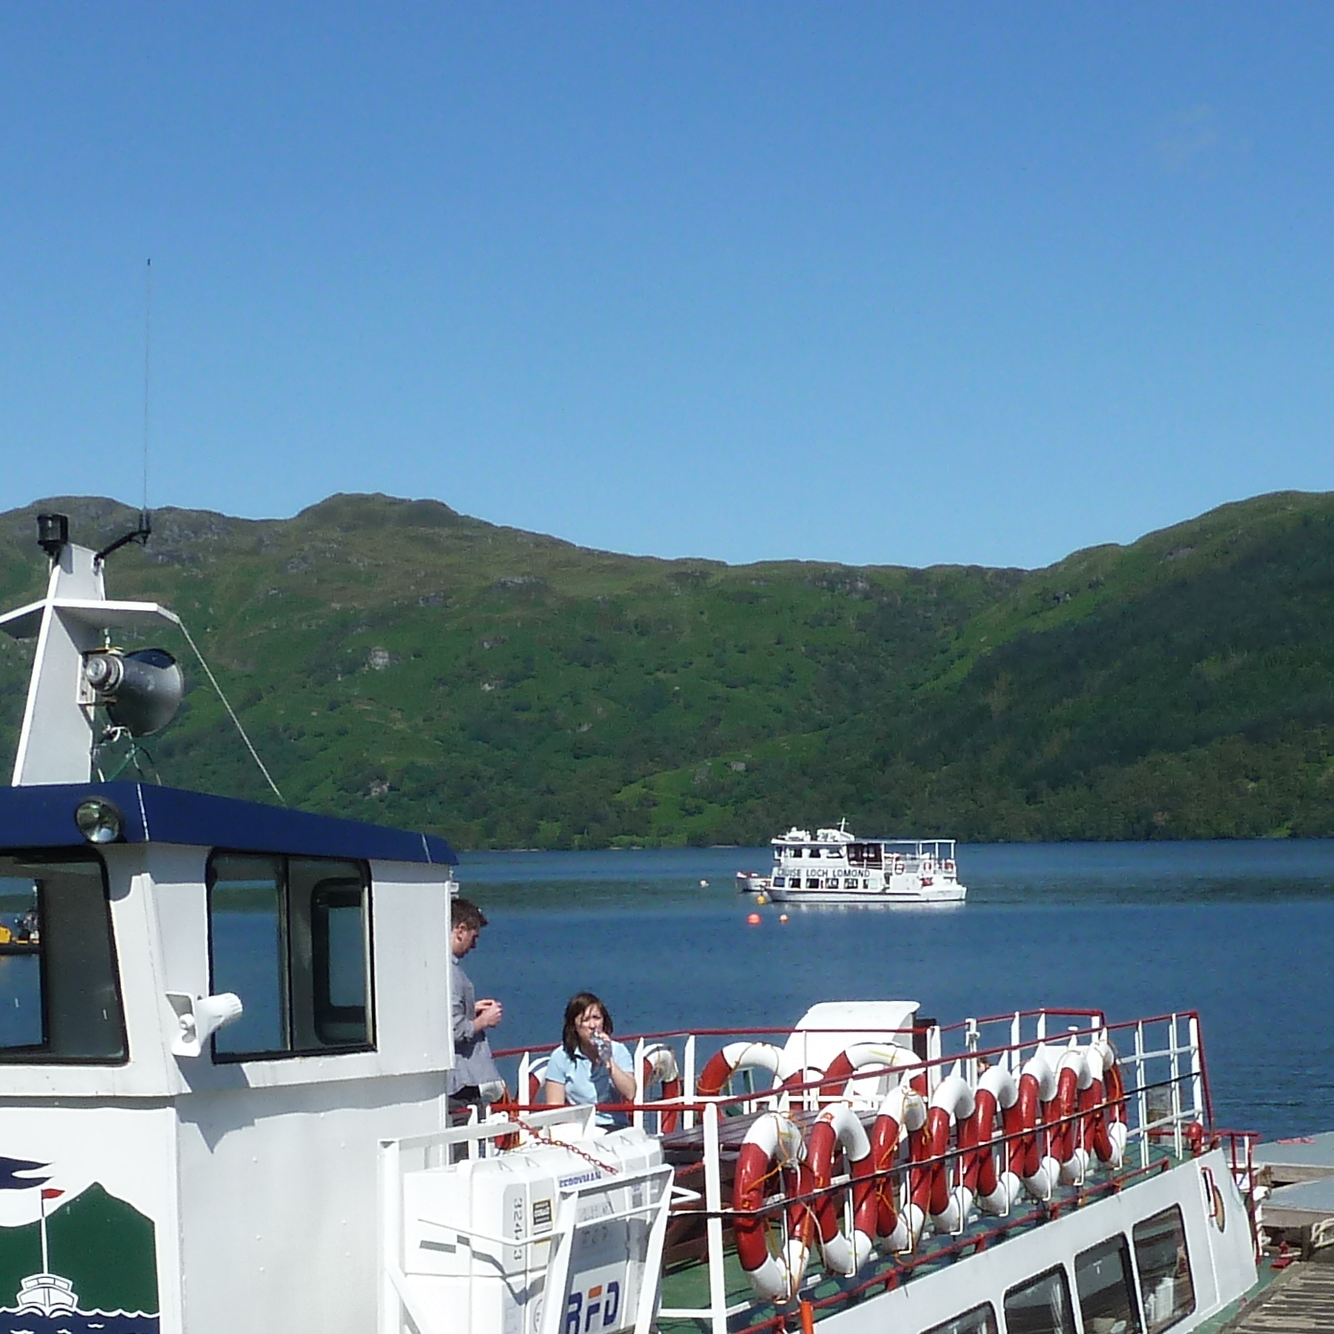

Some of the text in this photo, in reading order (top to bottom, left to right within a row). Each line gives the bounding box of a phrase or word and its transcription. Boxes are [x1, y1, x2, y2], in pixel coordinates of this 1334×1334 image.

[806, 869, 828, 878] LOCH
[833, 869, 871, 878] LOMOND
[513, 1197, 523, 1260] 3243
